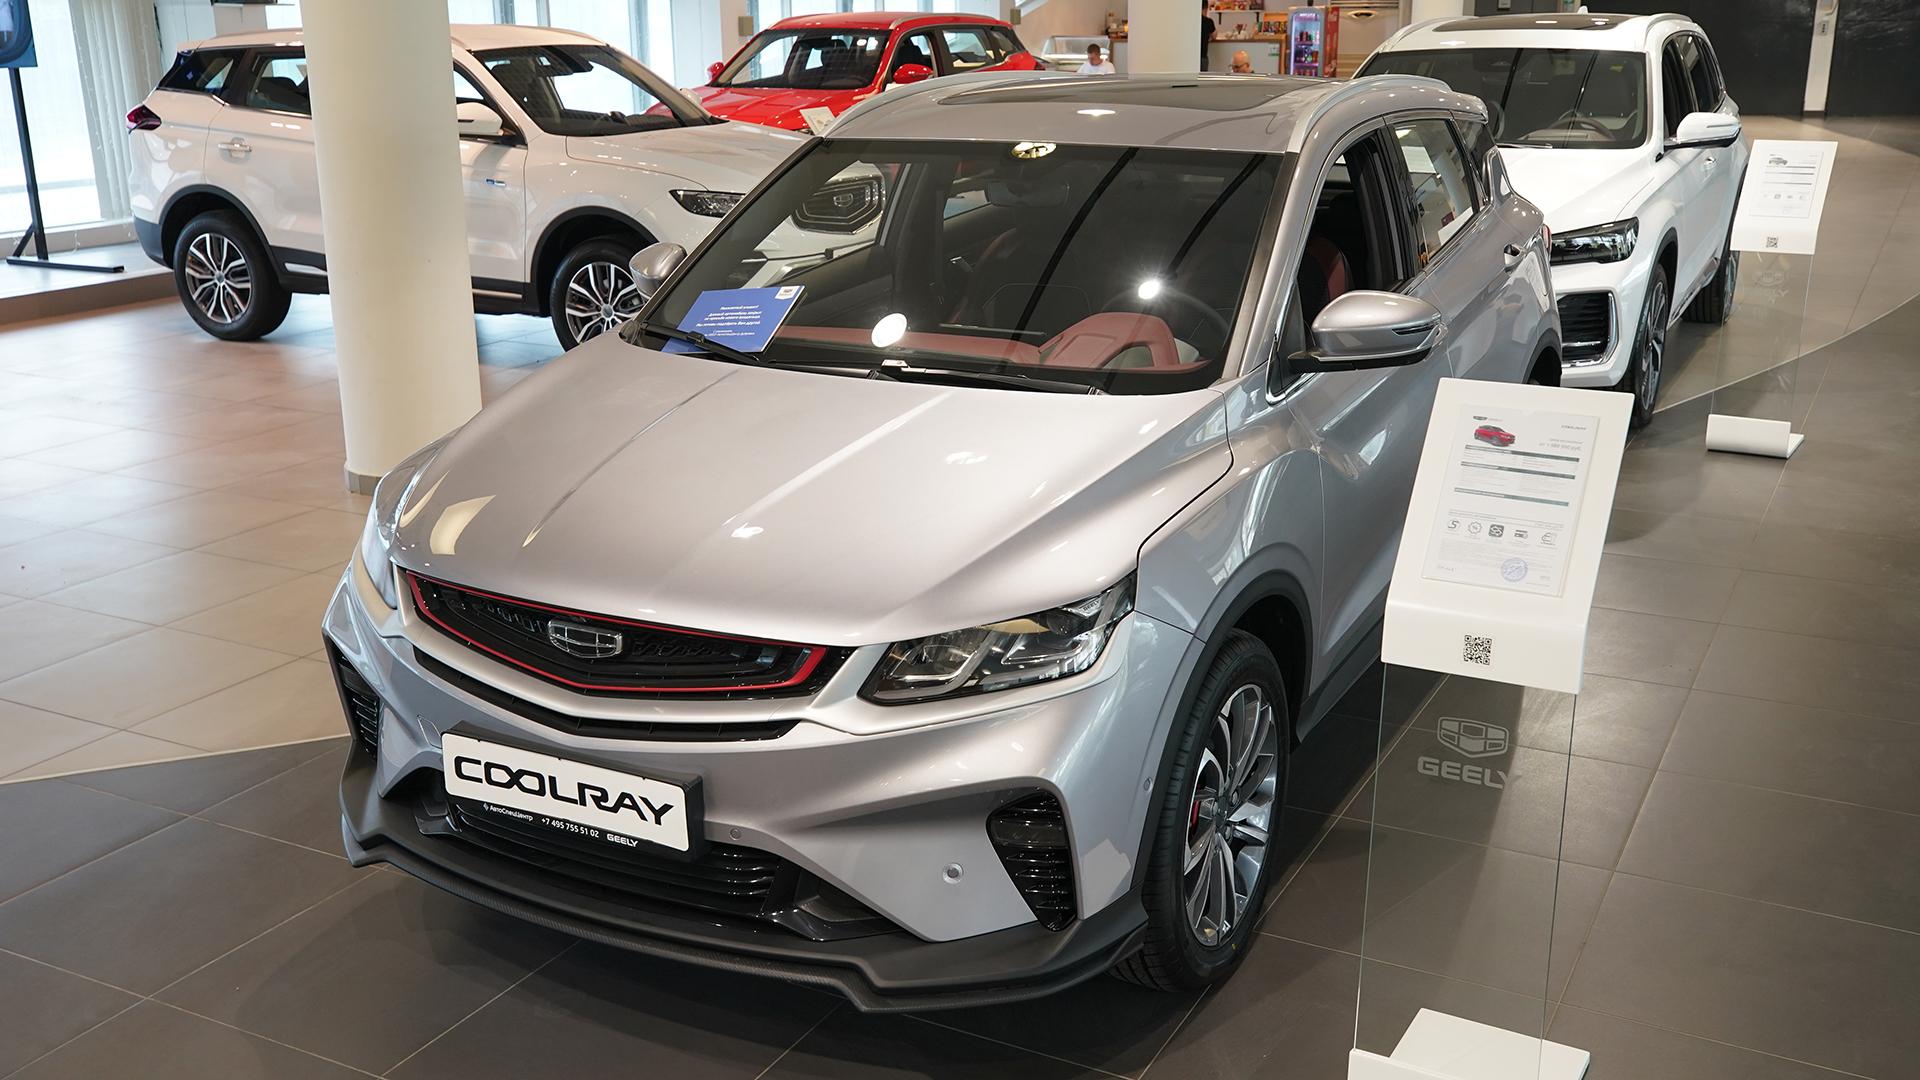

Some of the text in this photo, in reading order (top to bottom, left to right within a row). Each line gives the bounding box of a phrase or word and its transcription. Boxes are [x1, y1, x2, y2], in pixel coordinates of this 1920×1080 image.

[454, 756, 674, 826] COOLRAY
[489, 804, 639, 848] АвтоСпецЦентр +7 495 755 51 02 GEELY
